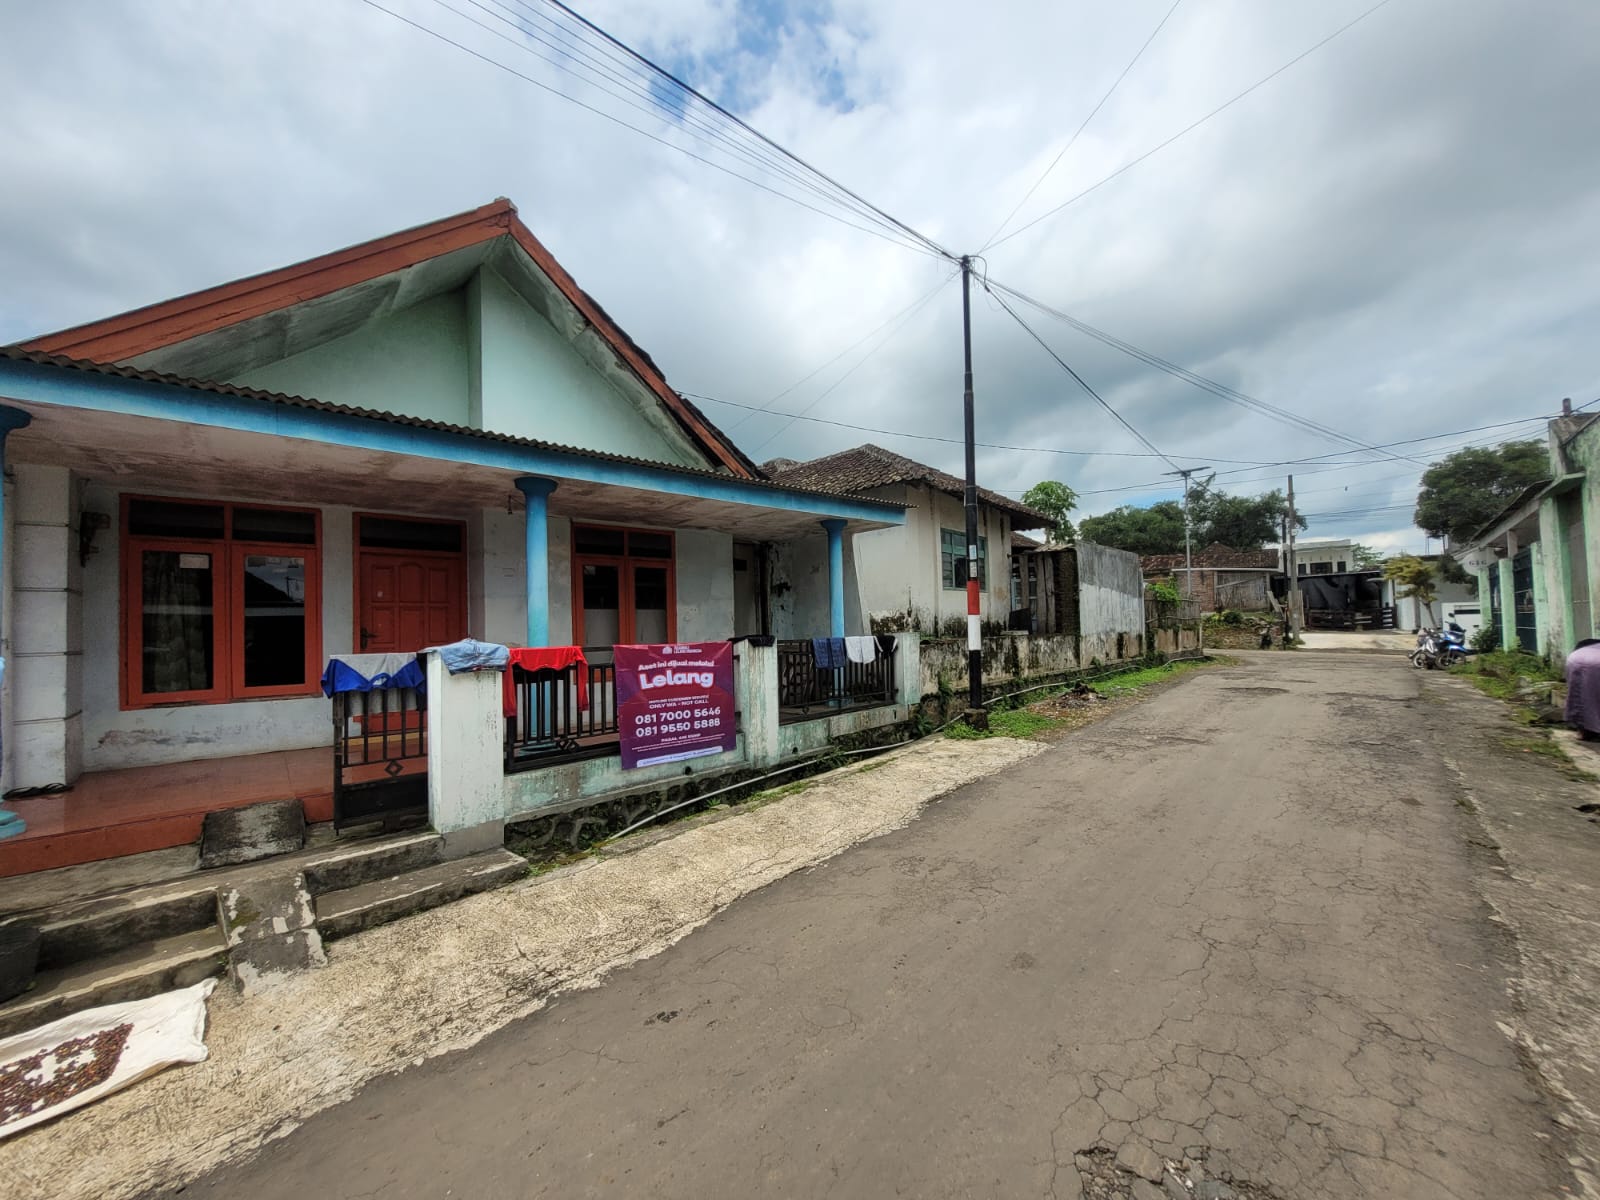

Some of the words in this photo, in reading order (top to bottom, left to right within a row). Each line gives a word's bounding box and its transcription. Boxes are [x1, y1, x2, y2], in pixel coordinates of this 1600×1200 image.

[638, 663, 656, 671] Aset
[667, 660, 688, 668] dijual
[639, 669, 714, 690] Lelang
[635, 714, 657, 725] 081
[660, 710, 691, 722] 7000
[694, 706, 721, 718] 5646
[636, 726, 658, 737] 081
[660, 722, 691, 734] 9550
[694, 718, 720, 729] 5888
